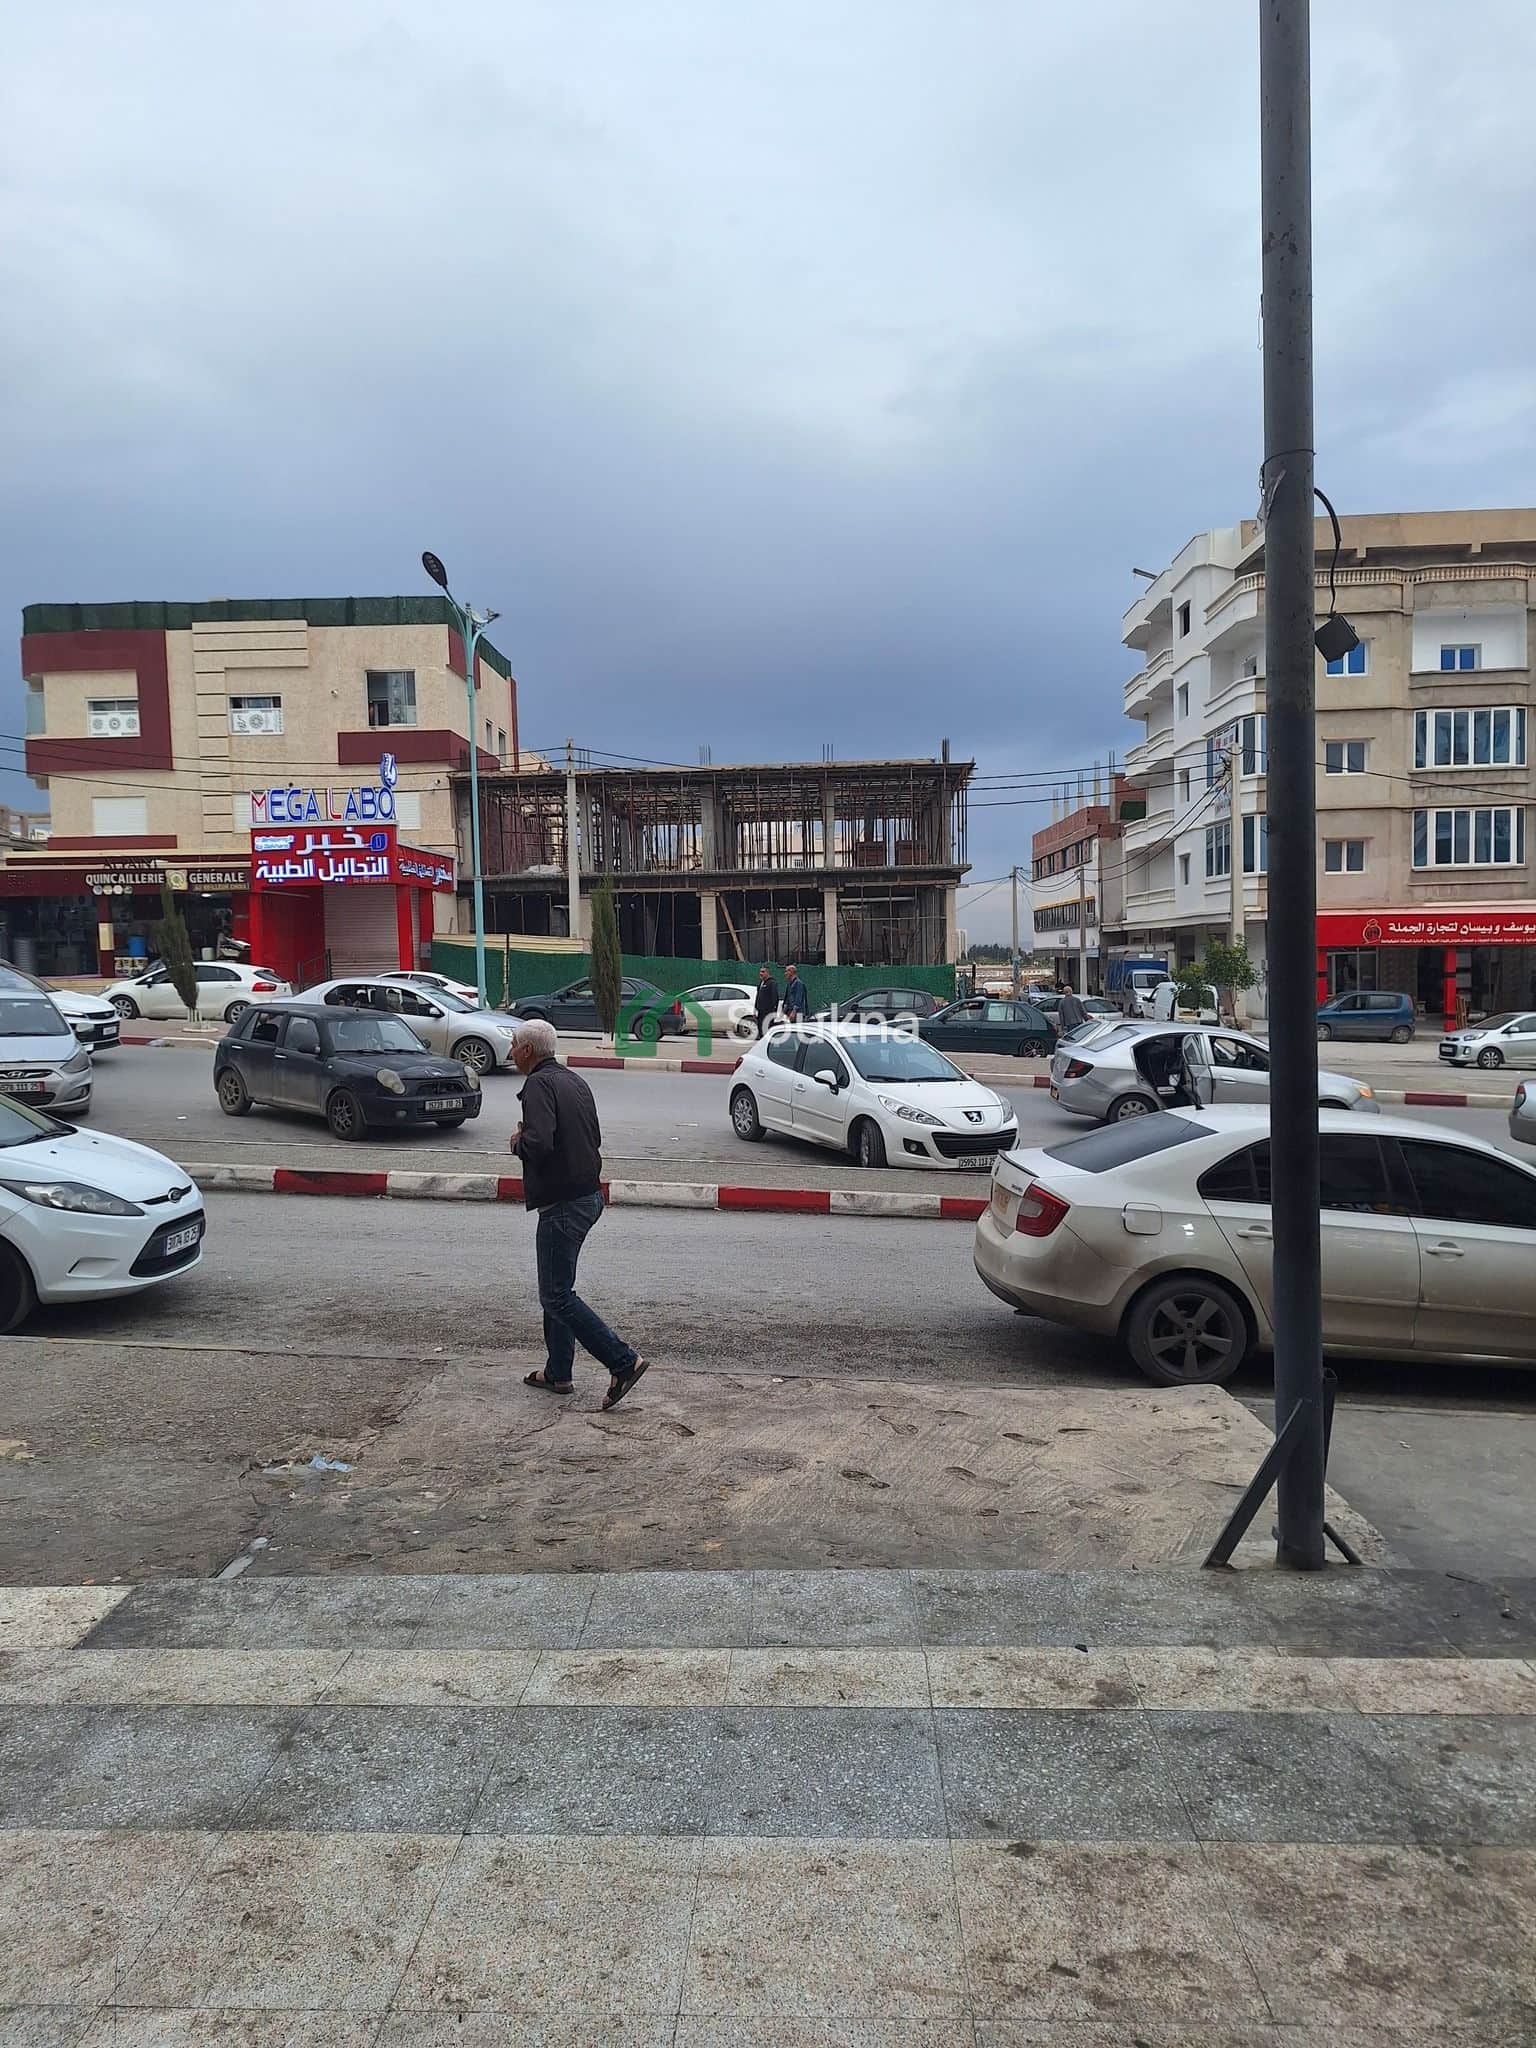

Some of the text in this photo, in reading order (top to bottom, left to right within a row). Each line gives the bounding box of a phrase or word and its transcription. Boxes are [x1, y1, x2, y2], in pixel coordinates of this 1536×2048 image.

[250, 786, 395, 822] MEGA LABO
[296, 826, 387, 855] مخبر
[86, 868, 245, 886] QUINCAILLERIE GÉNÉRALE
[255, 856, 388, 882] التحاليل الطبية
[1388, 922, 1425, 934] الجملة
[1426, 921, 1458, 935] لتجارة
